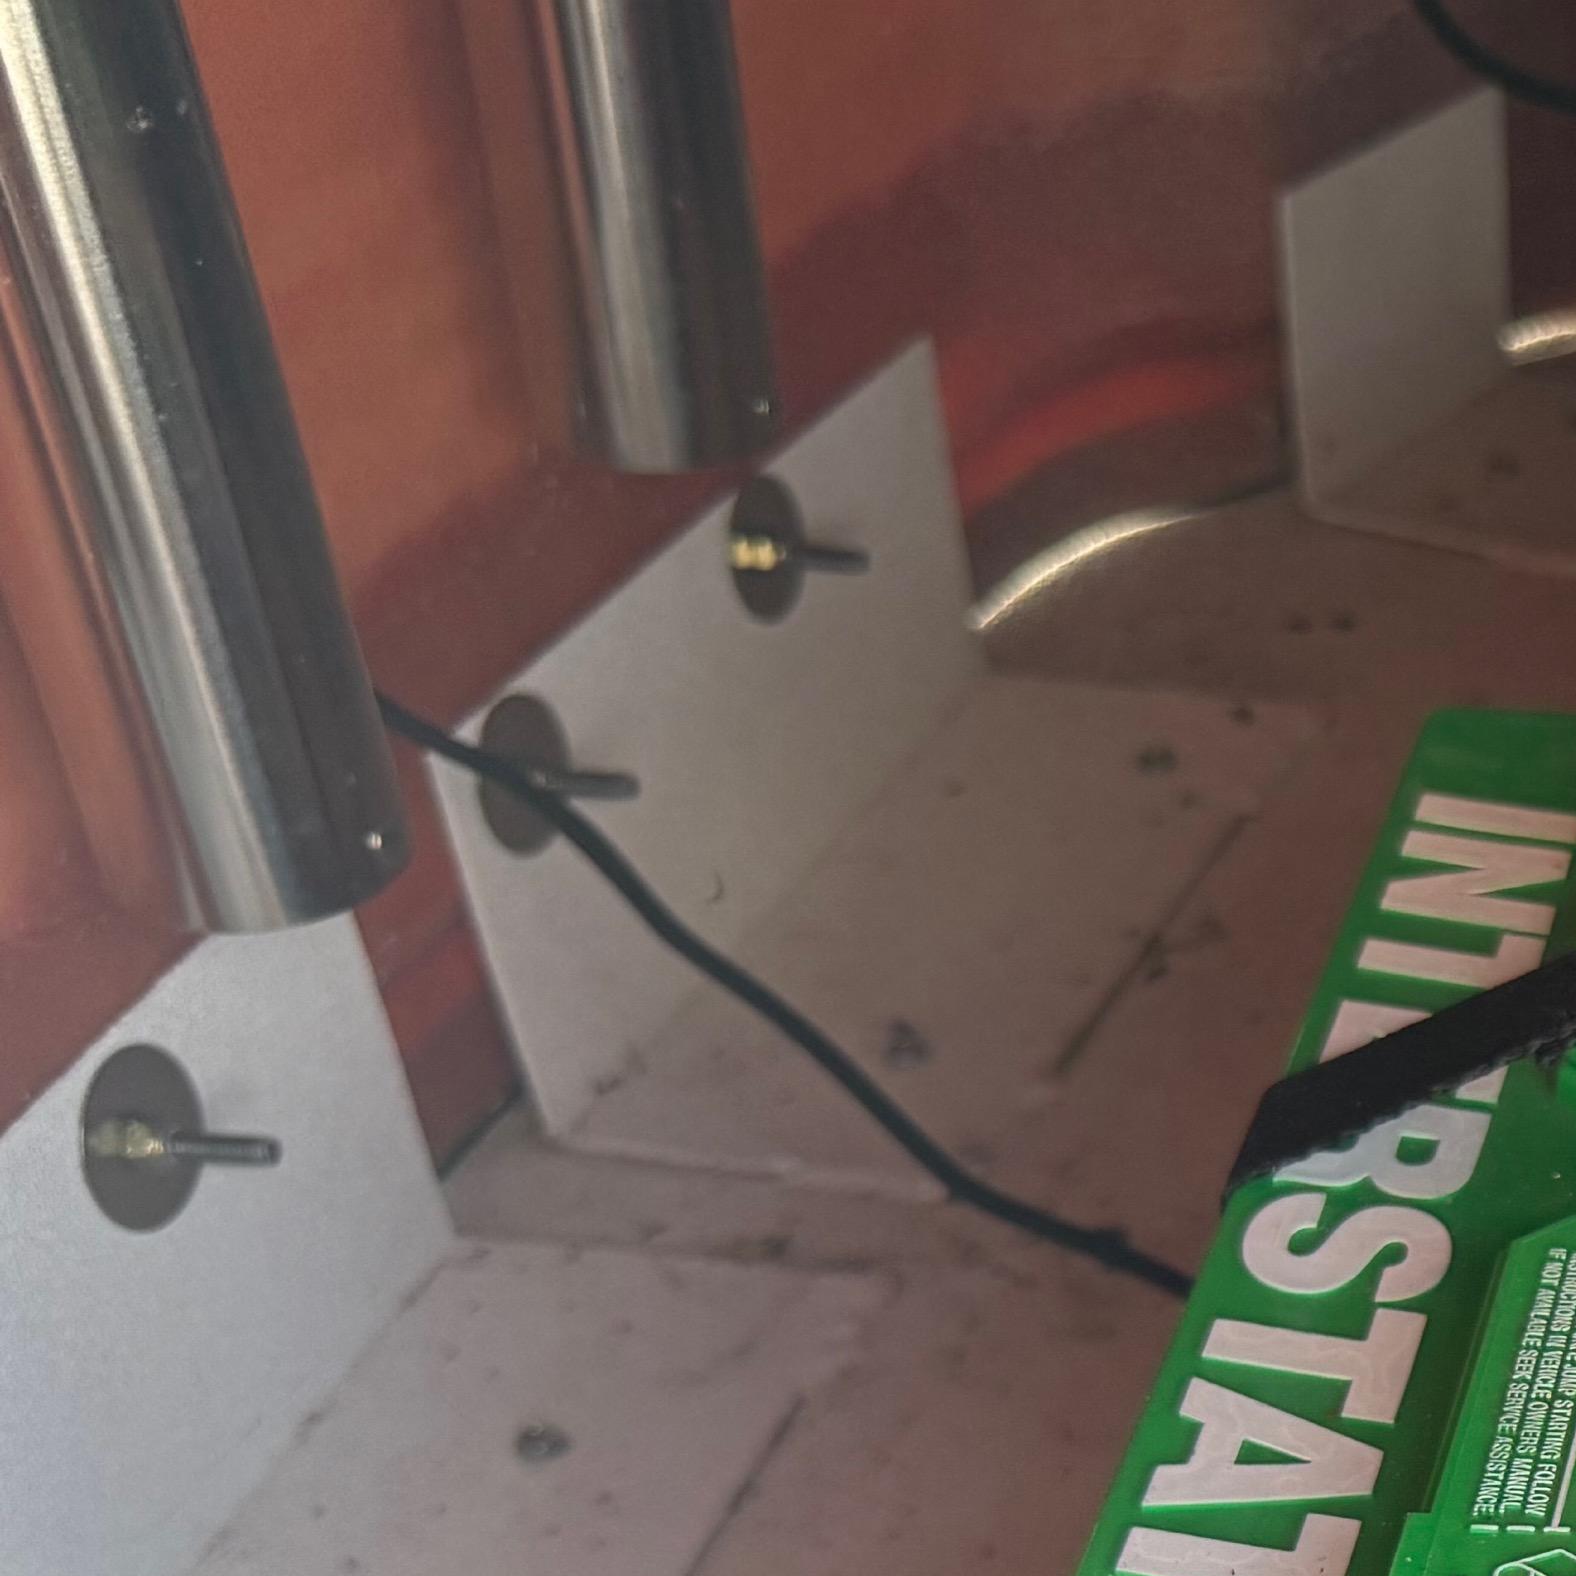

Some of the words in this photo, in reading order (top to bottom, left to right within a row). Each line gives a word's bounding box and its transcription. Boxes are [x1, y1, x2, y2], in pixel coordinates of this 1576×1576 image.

[1540, 1262, 1563, 1284] NOT
[1548, 1248, 1567, 1258] IF
[1521, 1289, 1555, 1345] AVAILABLE
[1545, 1335, 1567, 1346] IN
[1511, 1350, 1538, 1378] SEEK
[1530, 1351, 1563, 1397] VEHICLE
[1497, 1383, 1529, 1432] SERVICE
[1516, 1402, 1548, 1453] OWNERS
[1539, 1400, 1573, 1459] STARTING
[1524, 1463, 1557, 1515] FOLLOW
